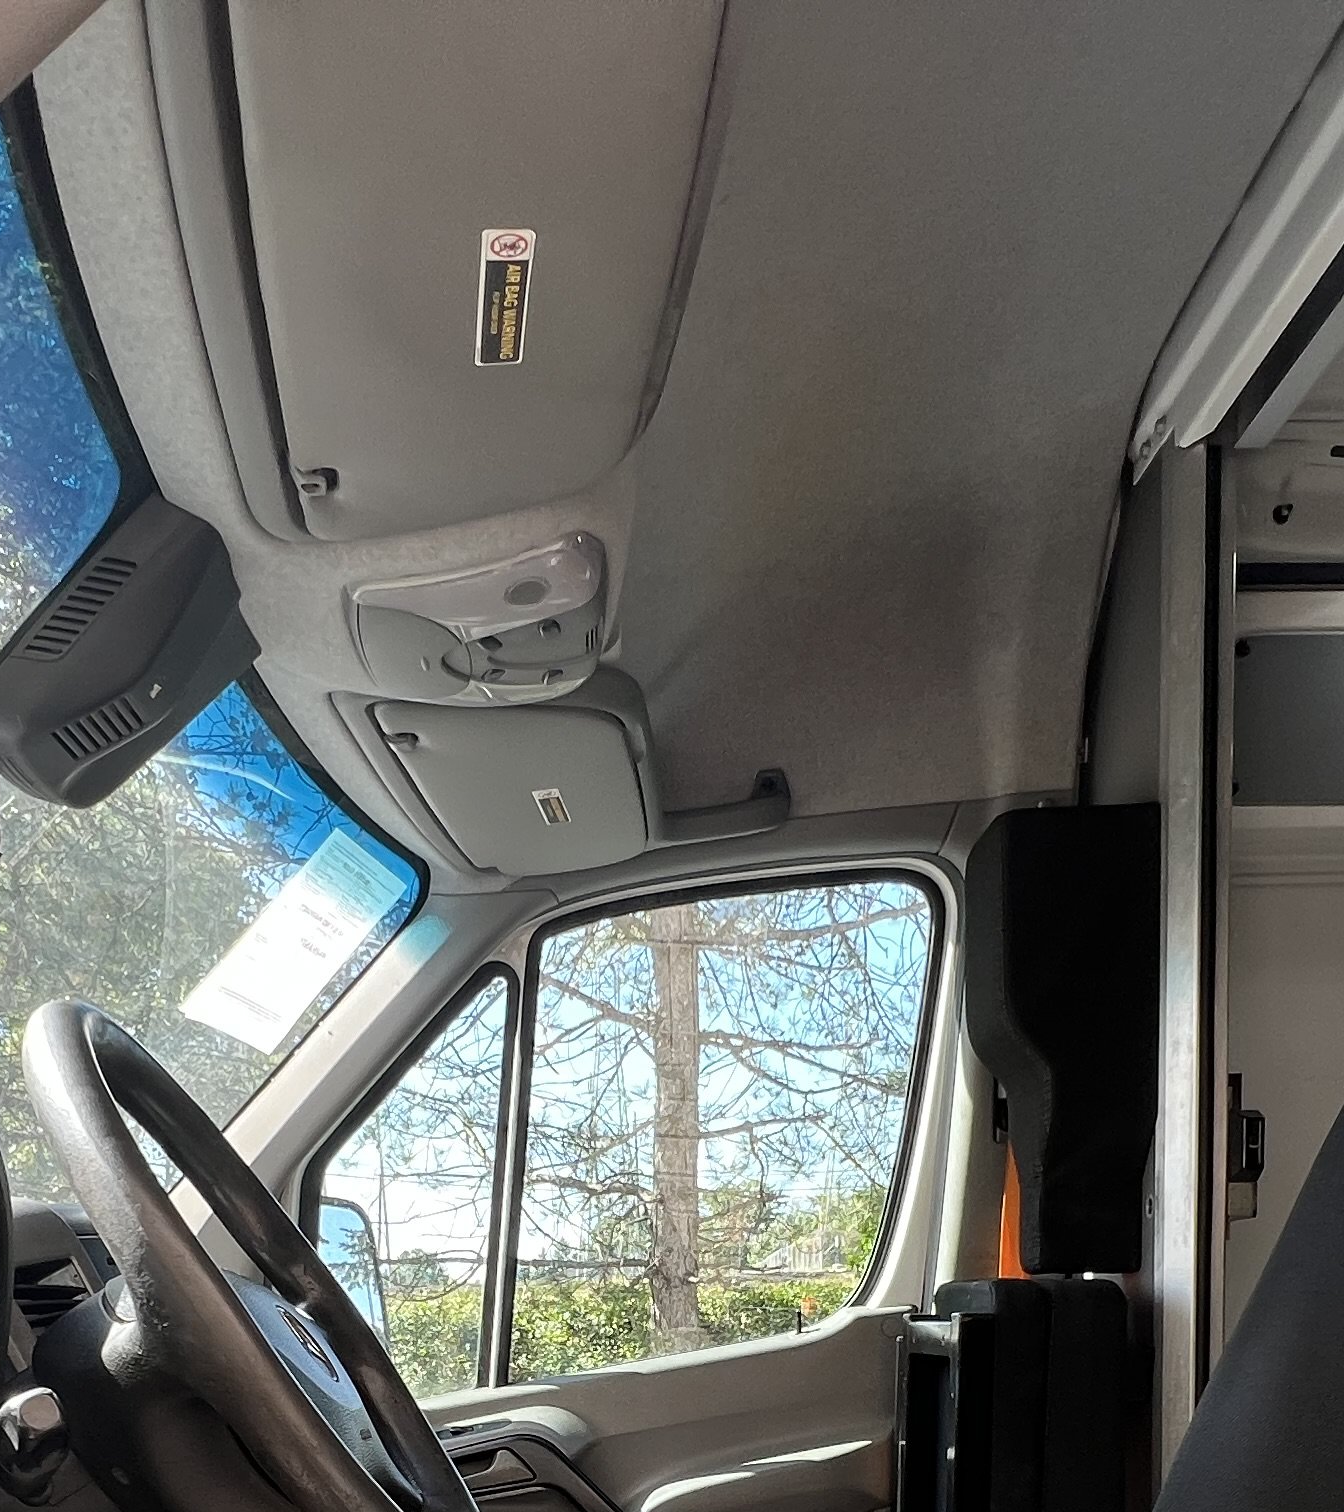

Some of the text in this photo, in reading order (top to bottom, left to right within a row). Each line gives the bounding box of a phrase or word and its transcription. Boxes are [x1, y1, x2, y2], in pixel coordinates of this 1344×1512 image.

[499, 263, 522, 361] AIR BAG WARNING
